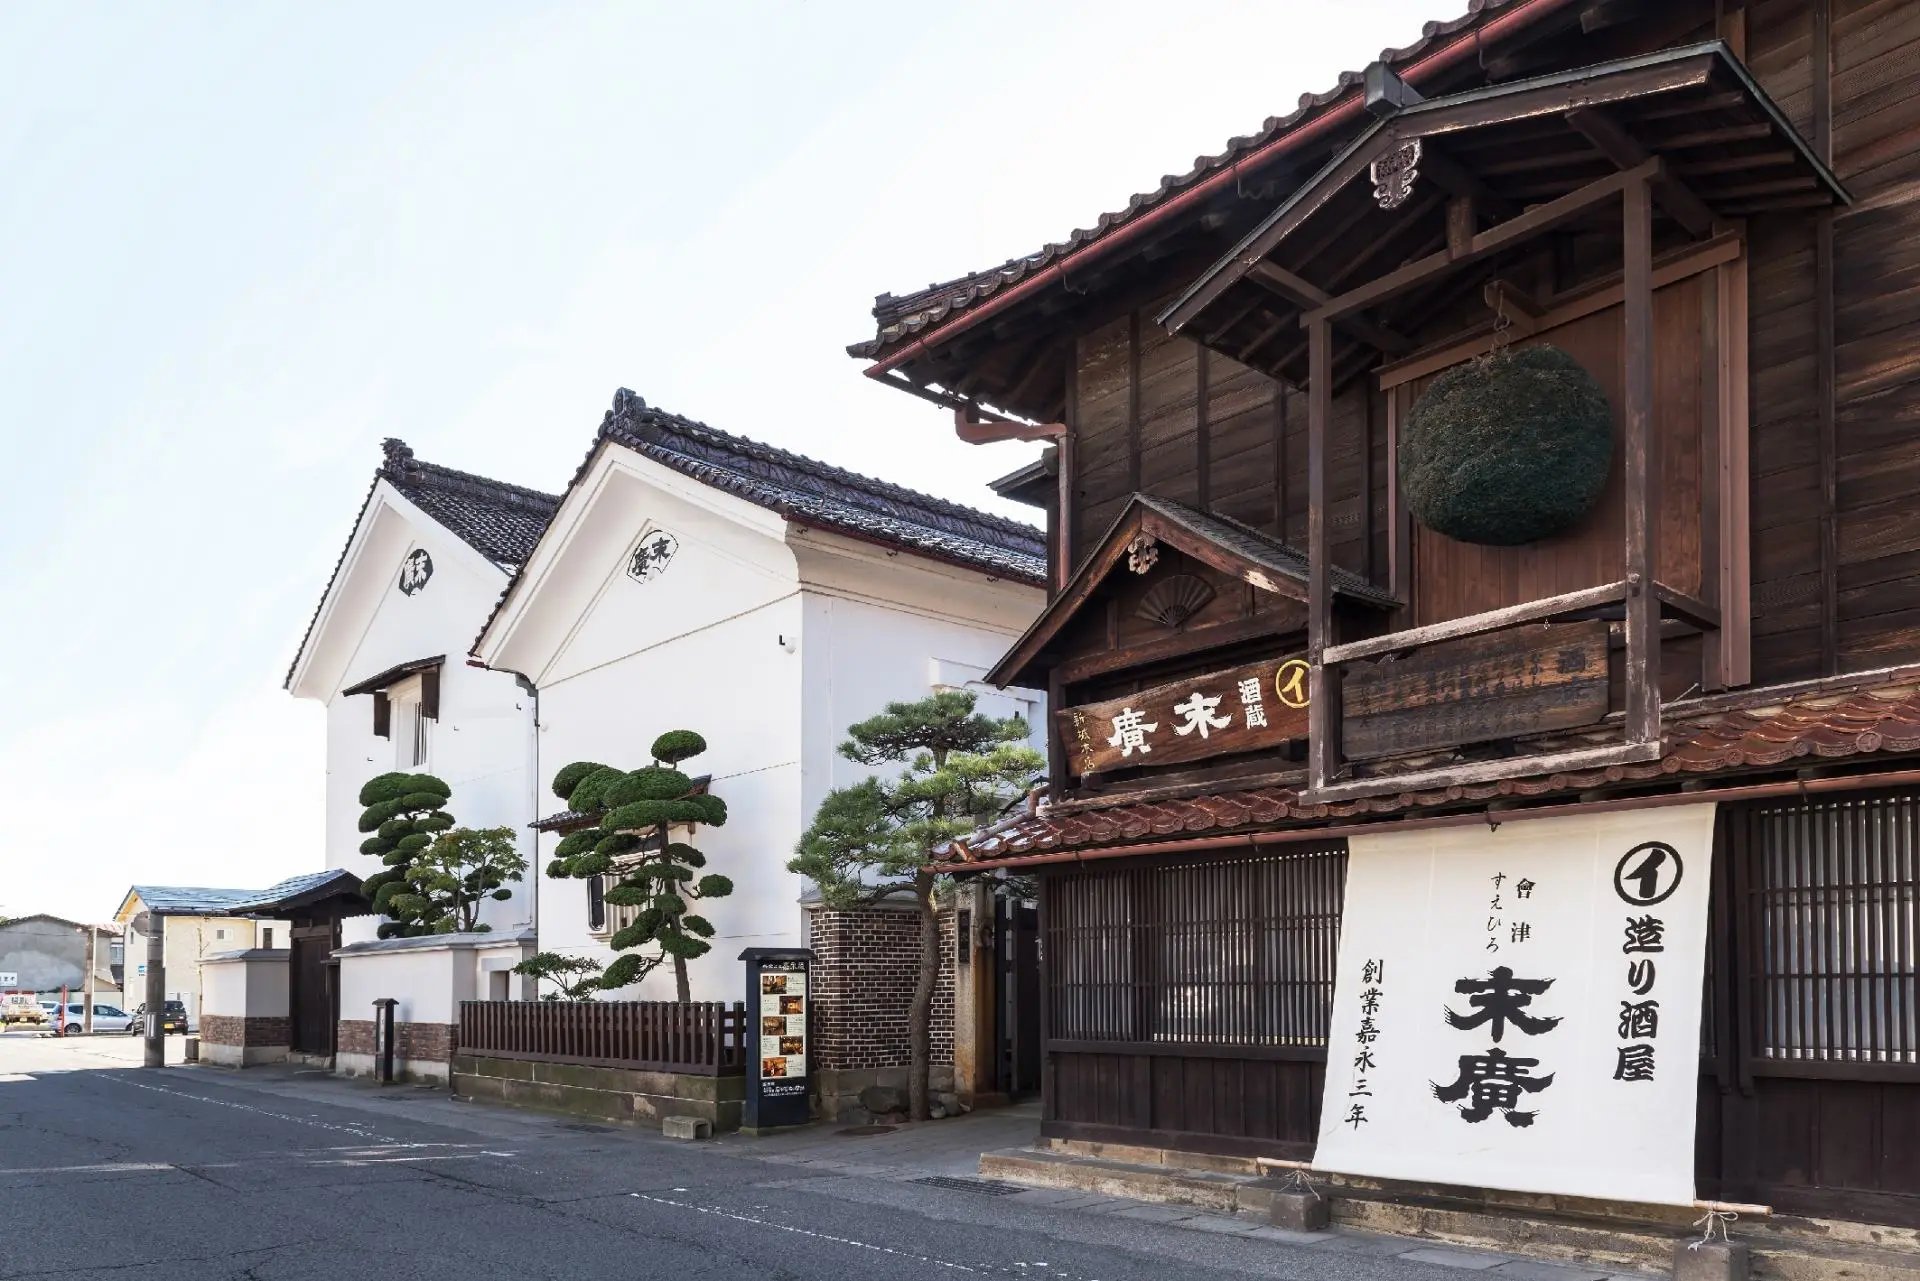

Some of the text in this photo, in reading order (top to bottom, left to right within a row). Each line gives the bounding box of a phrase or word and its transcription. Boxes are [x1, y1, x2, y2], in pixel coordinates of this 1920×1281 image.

[1237, 677, 1268, 730] 酒蔵
[1486, 871, 1507, 954] すえひろ
[1510, 877, 1536, 943] 會津
[1344, 958, 1384, 1130] 創業嘉永三年
[1428, 965, 1565, 1128] 末廣
[1612, 914, 1664, 1082] 造り酒屋
